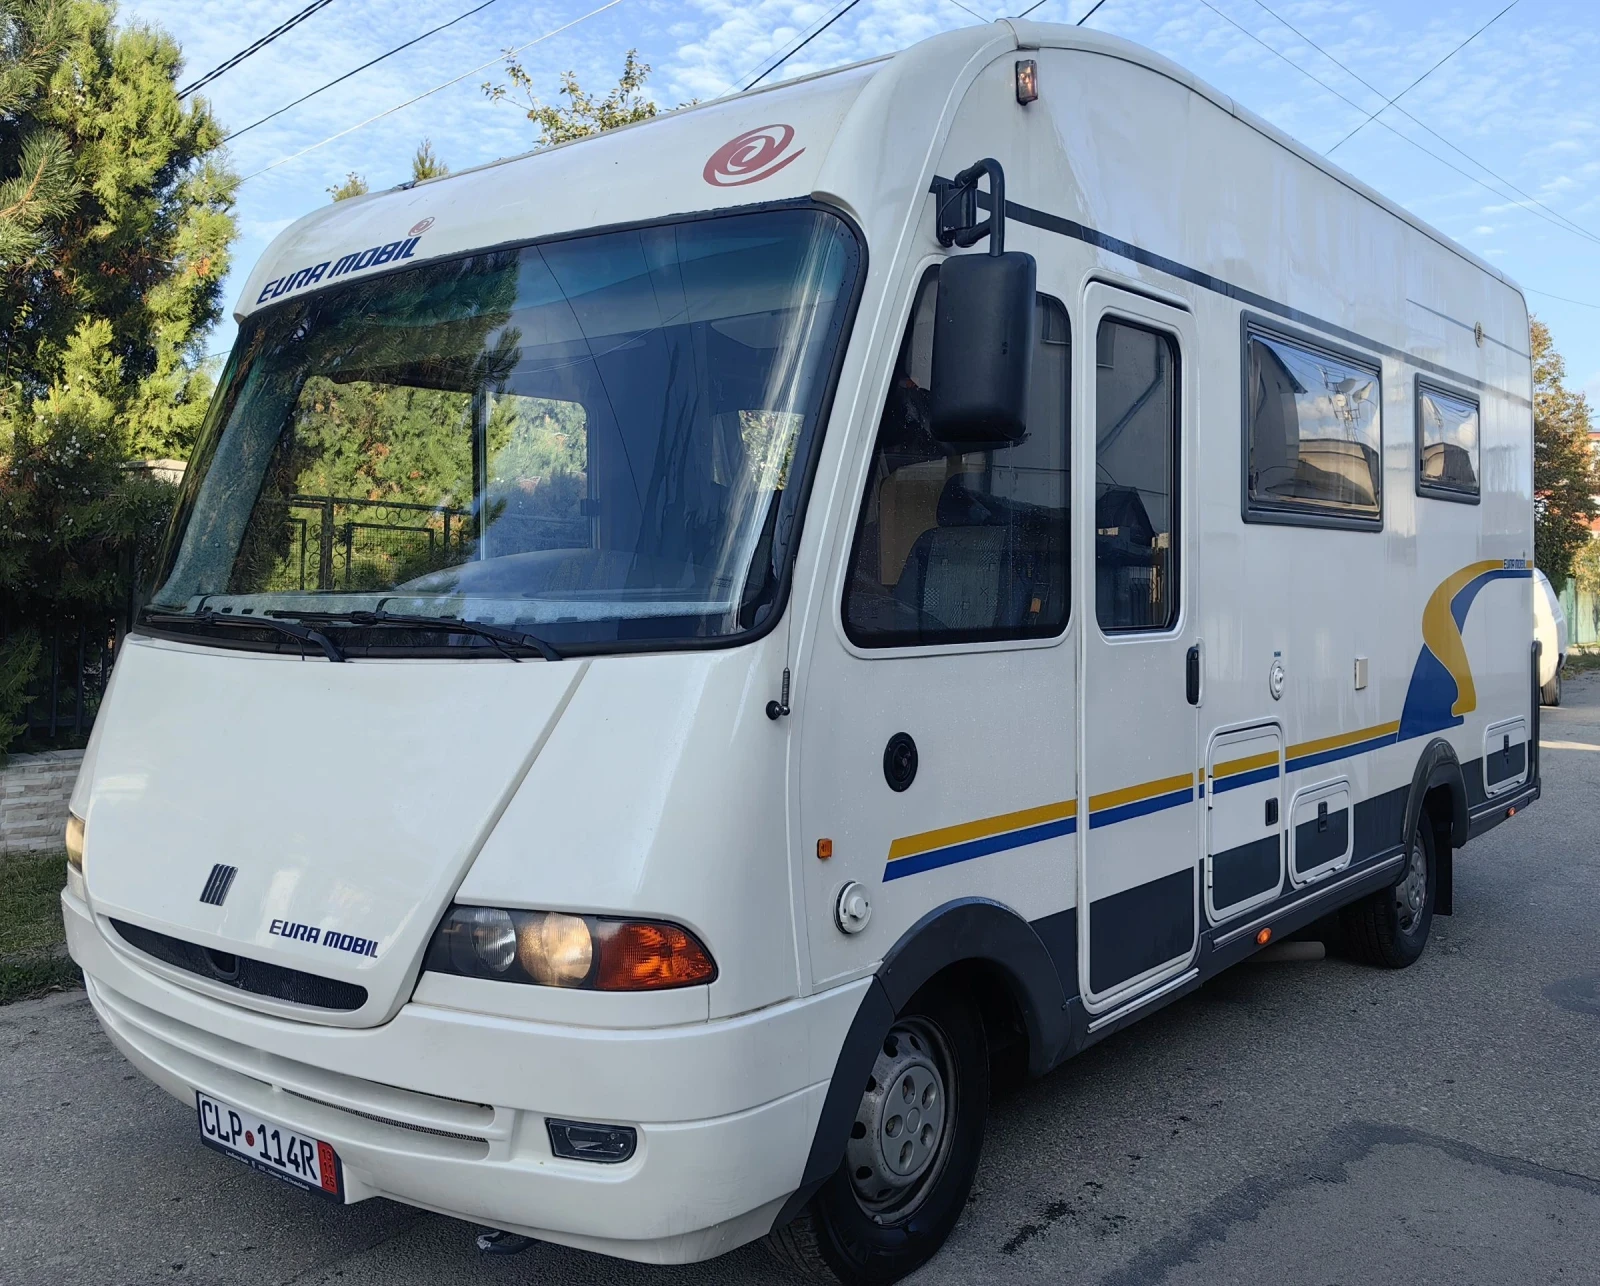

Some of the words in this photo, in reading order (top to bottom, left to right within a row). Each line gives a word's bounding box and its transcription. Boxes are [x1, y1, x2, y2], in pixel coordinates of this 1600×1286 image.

[256, 260, 332, 305] EURA
[327, 236, 422, 279] MOBIL
[269, 919, 321, 944] EURA
[322, 930, 379, 958] MOBIL
[201, 1100, 242, 1146] CLP
[257, 1124, 318, 1180] 114R
[321, 1148, 333, 1162] 13
[323, 1161, 334, 1175] 11
[324, 1174, 335, 1188] 25
